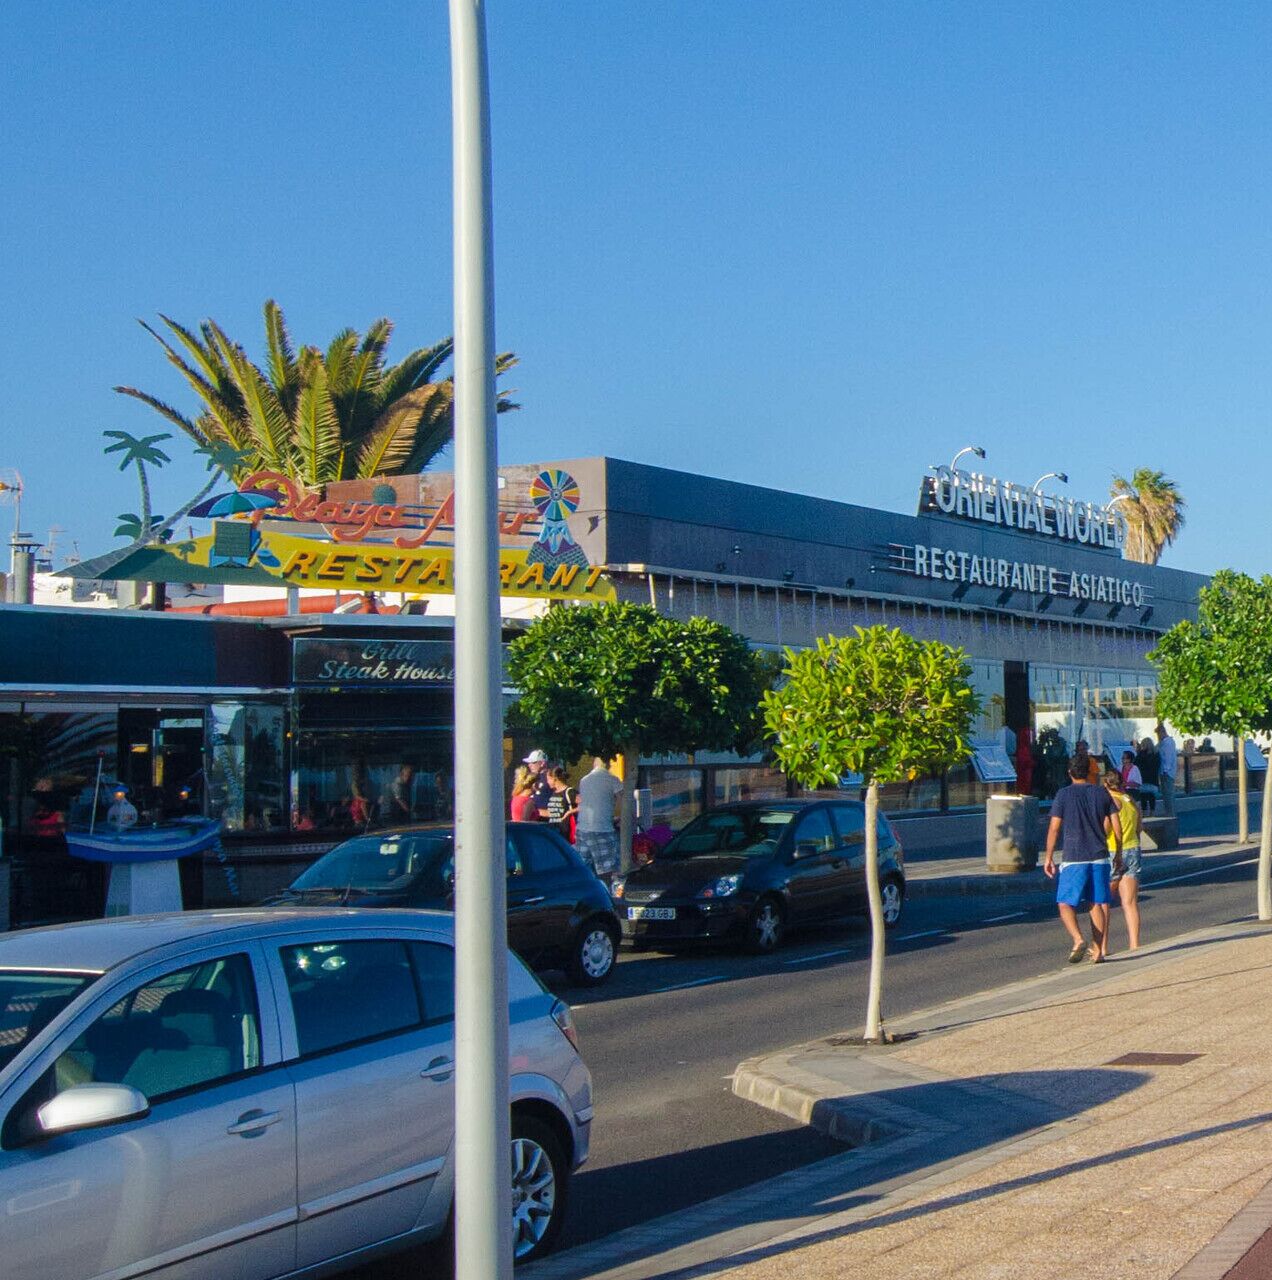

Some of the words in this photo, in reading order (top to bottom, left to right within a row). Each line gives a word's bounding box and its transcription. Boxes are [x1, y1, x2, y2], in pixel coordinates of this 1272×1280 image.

[239, 471, 406, 542] Playa
[934, 465, 1055, 534] ORIENTAL
[1052, 493, 1127, 549] WORLD
[281, 550, 608, 592] RESTARANT
[914, 544, 1058, 595] RESTAURANTE
[1068, 571, 1142, 608] ASIATICO
[318, 660, 390, 680] Steak
[361, 641, 417, 661] Grill
